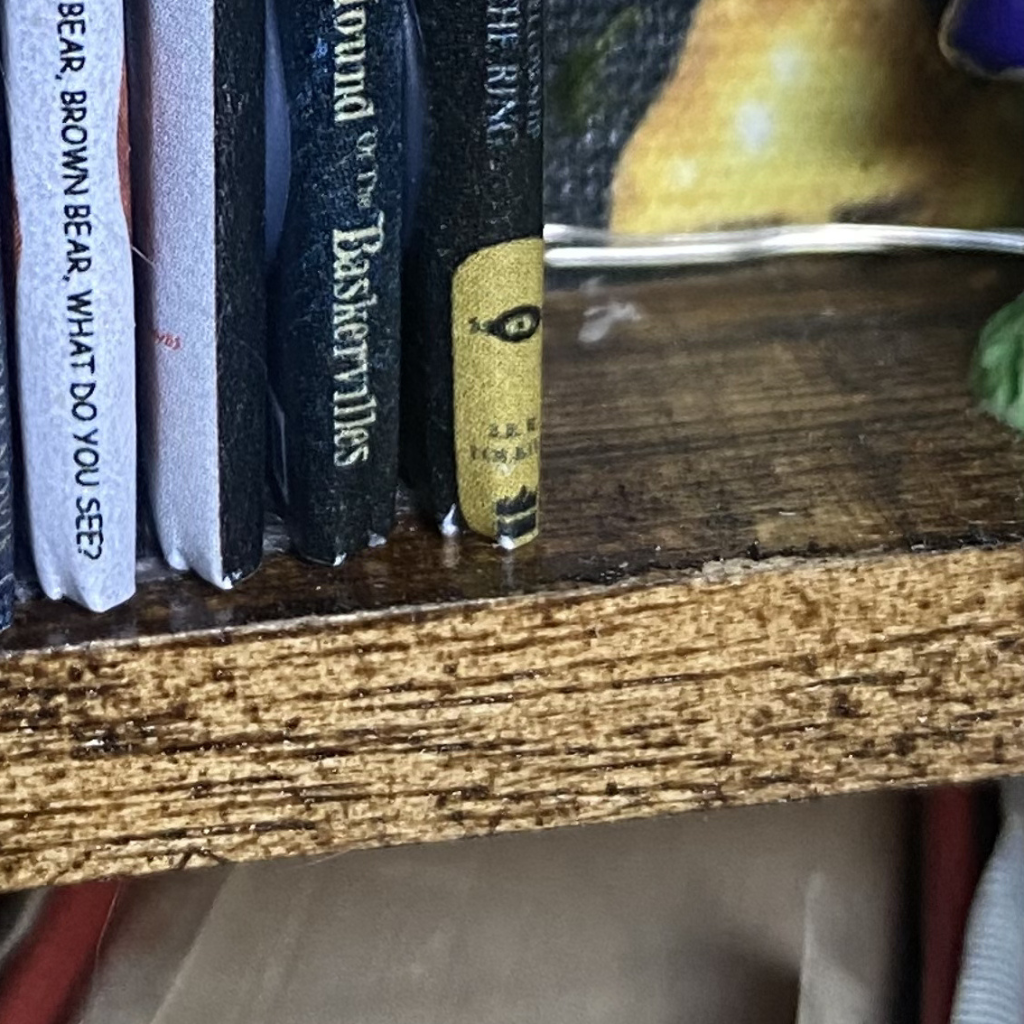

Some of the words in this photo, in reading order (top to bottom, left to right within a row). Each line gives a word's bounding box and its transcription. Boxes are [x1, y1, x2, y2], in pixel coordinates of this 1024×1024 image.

[54, 2, 86, 80] BEAR,
[60, 90, 89, 196] BROWN
[484, 63, 521, 151] RING
[62, 204, 93, 281] BEAR,
[66, 288, 95, 376] WHAT
[332, 210, 384, 466] Baskervilles
[69, 382, 98, 423] DO
[73, 428, 100, 487] YOU
[74, 496, 105, 561] SEE?
